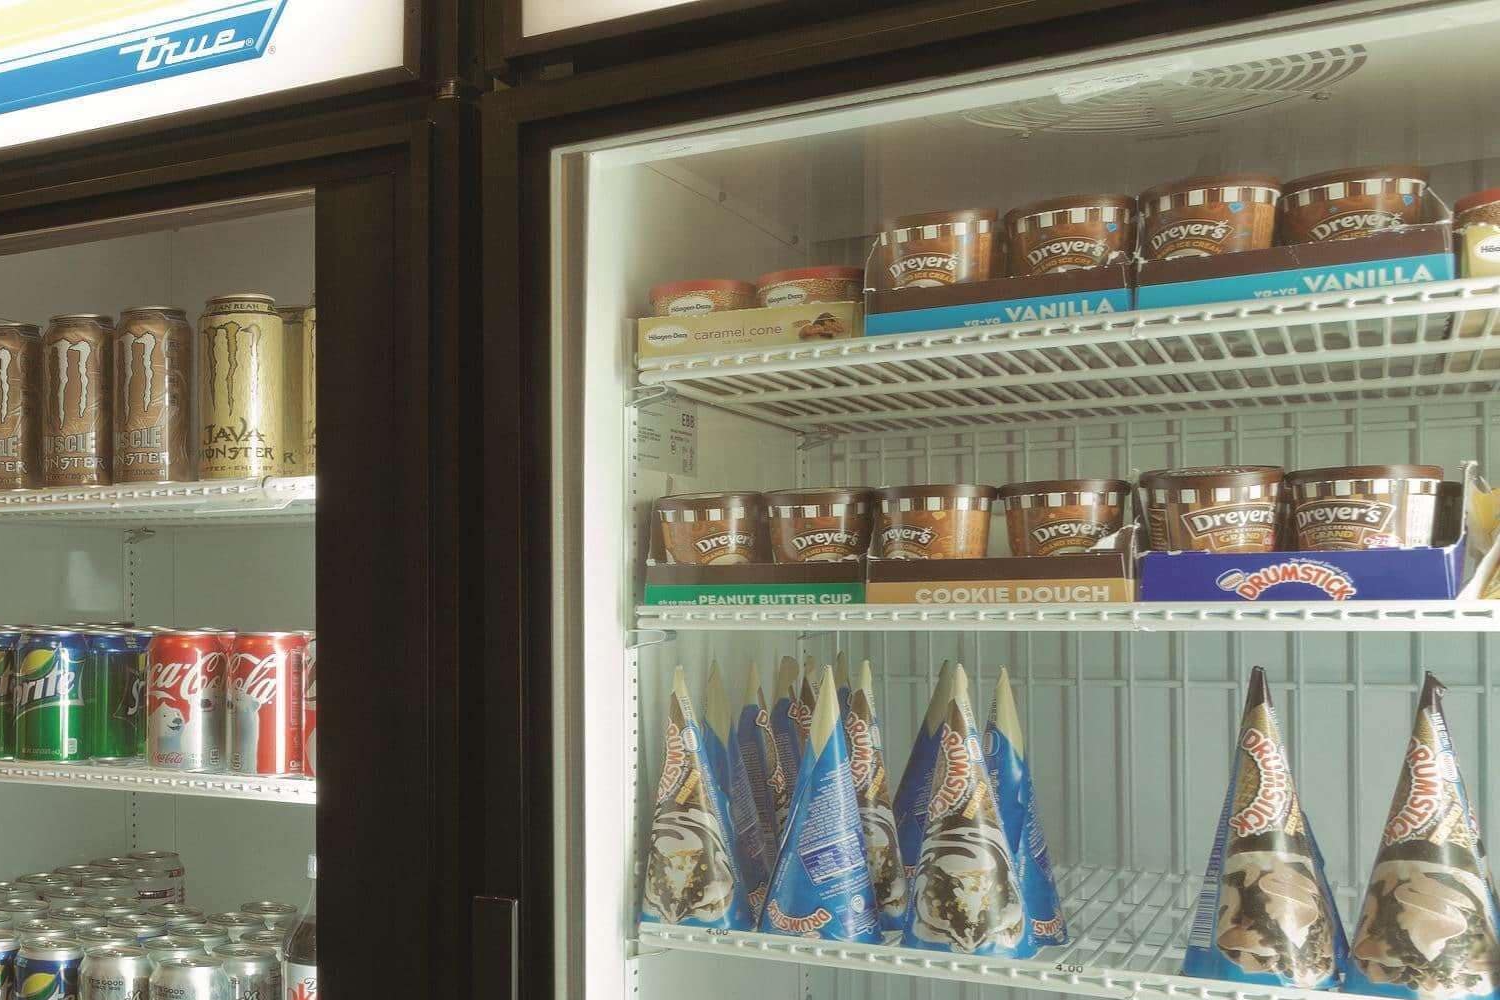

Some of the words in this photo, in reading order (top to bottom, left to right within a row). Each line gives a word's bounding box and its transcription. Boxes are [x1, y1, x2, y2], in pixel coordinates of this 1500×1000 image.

[1304, 263, 1435, 293] VANILLA
[1005, 298, 1116, 322] VANILLA
[693, 329, 745, 341] caramel
[750, 325, 783, 337] cone
[203, 417, 266, 445] JAVA
[1236, 562, 1358, 601] DRUMSTICK
[699, 595, 756, 606] PEANUT
[759, 594, 818, 605] BUTTER
[820, 594, 852, 605] CUP
[915, 586, 1010, 604] COOKIE
[1016, 585, 1110, 603] DOUGH
[1055, 963, 1085, 975] 4.00
